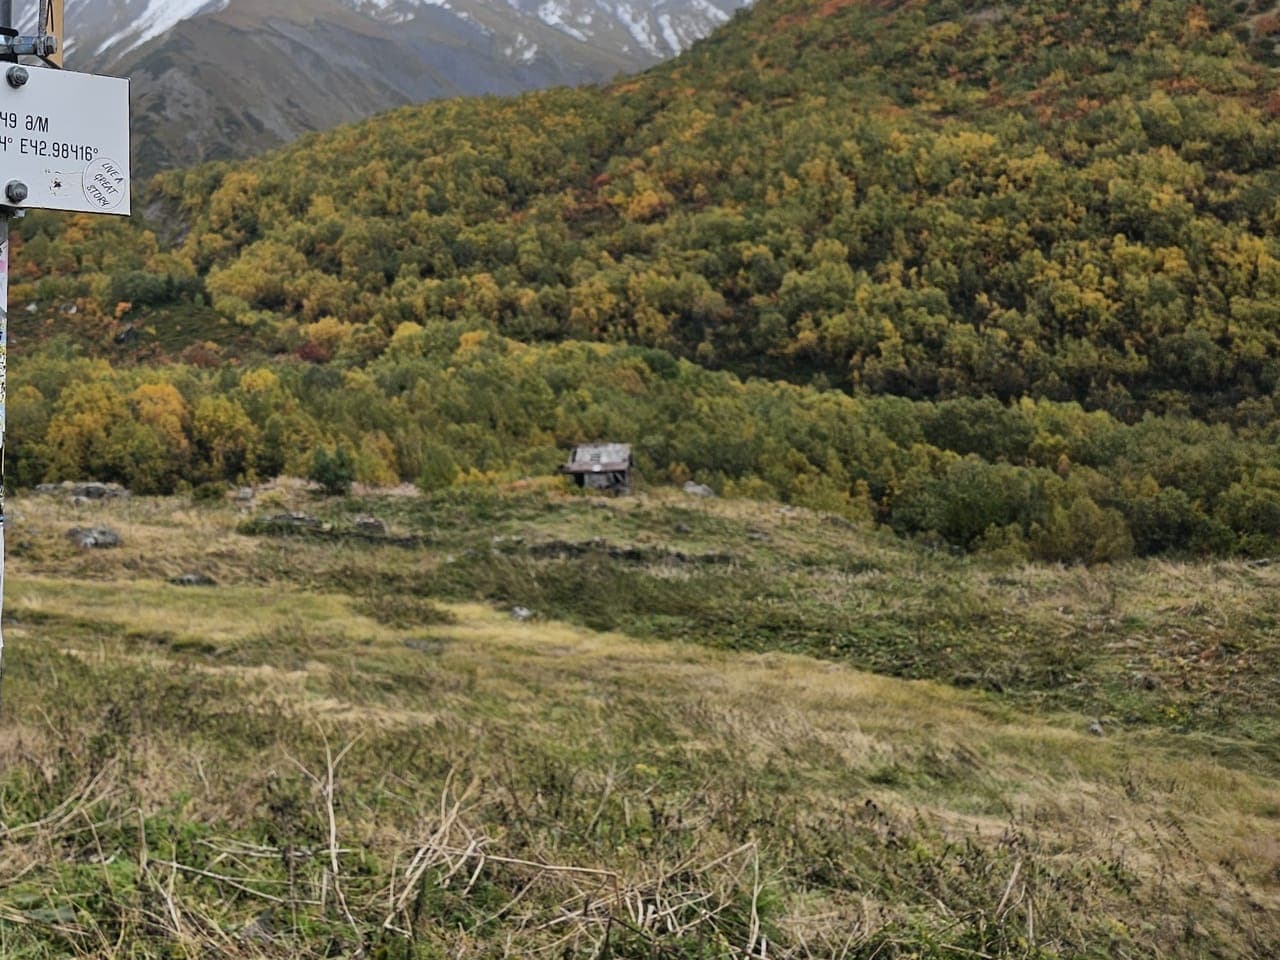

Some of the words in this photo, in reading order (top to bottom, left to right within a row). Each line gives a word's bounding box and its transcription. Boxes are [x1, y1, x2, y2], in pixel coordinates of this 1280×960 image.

[20, 138, 99, 162] E42.98416°
[93, 173, 119, 196] GREAT
[102, 162, 120, 180] LIVE
[115, 176, 124, 185] A
[86, 184, 109, 207] STORY
